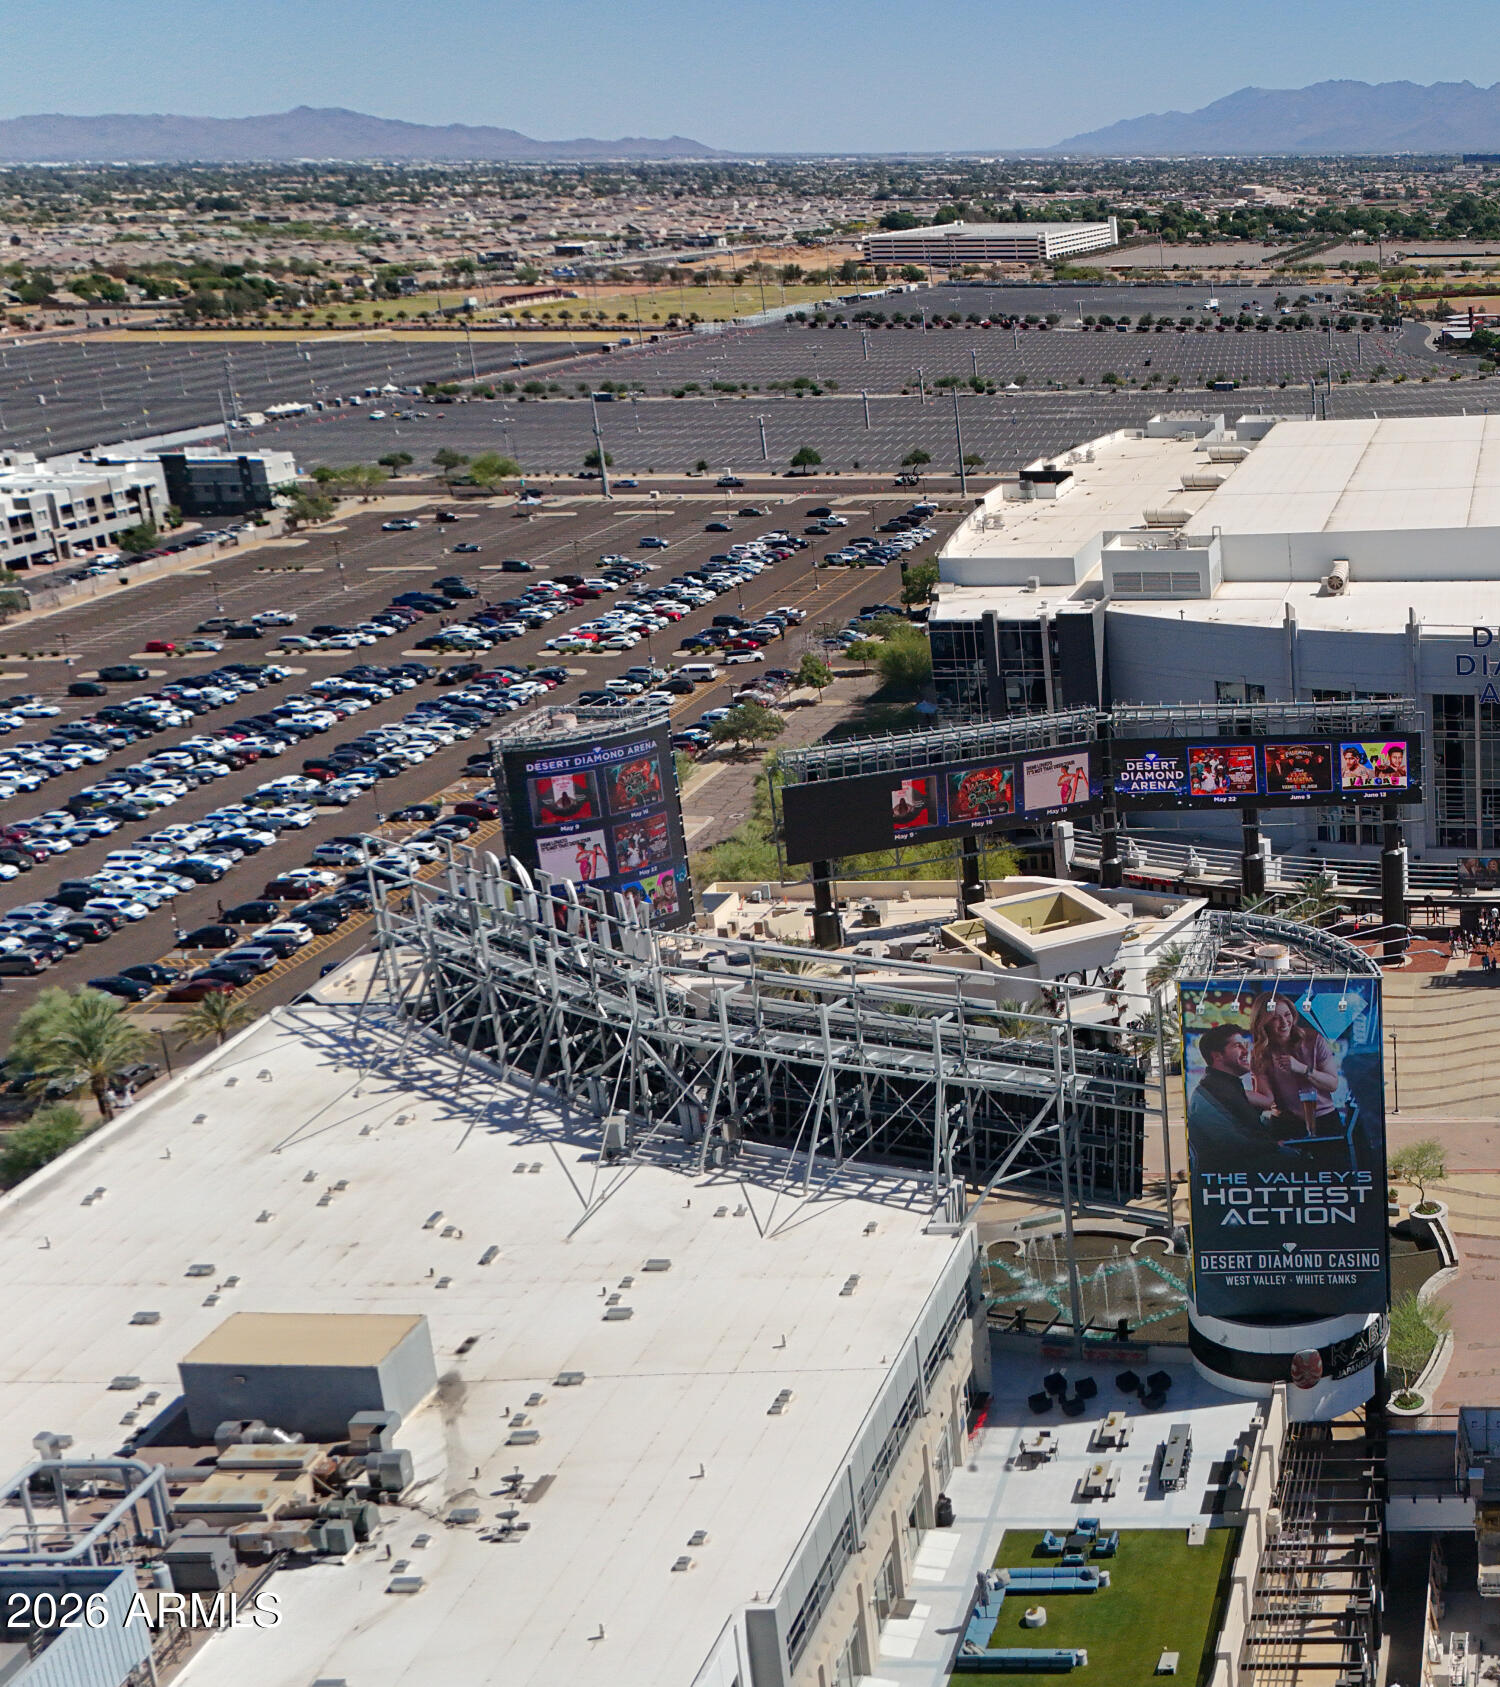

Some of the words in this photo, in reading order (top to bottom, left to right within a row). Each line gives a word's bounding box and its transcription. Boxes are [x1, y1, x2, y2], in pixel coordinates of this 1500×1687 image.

[526, 758, 571, 772] DESERT
[574, 748, 624, 766] DIAMOND
[627, 740, 658, 756] ARENA
[1126, 760, 1177, 771] DESERT
[1120, 770, 1185, 780] DIAMOND
[1130, 780, 1176, 790] ARENA
[630, 810, 644, 818] May
[1046, 808, 1060, 816] May
[560, 824, 574, 832] May
[894, 833, 906, 841] May
[638, 868, 650, 876] May
[1201, 1172, 1249, 1185] THE
[1257, 1171, 1372, 1184] VALLEY'S
[1202, 1186, 1373, 1206] HOTTEST
[1220, 1206, 1356, 1226] ACTION
[1200, 1254, 1254, 1270] DESERT
[1258, 1253, 1323, 1269] DIAMOND
[1328, 1252, 1381, 1268] CASINO
[1225, 1274, 1252, 1286] WEST
[1253, 1274, 1287, 1286] VALLEY
[1295, 1274, 1324, 1285] WHITE
[1326, 1274, 1357, 1284] TANKS
